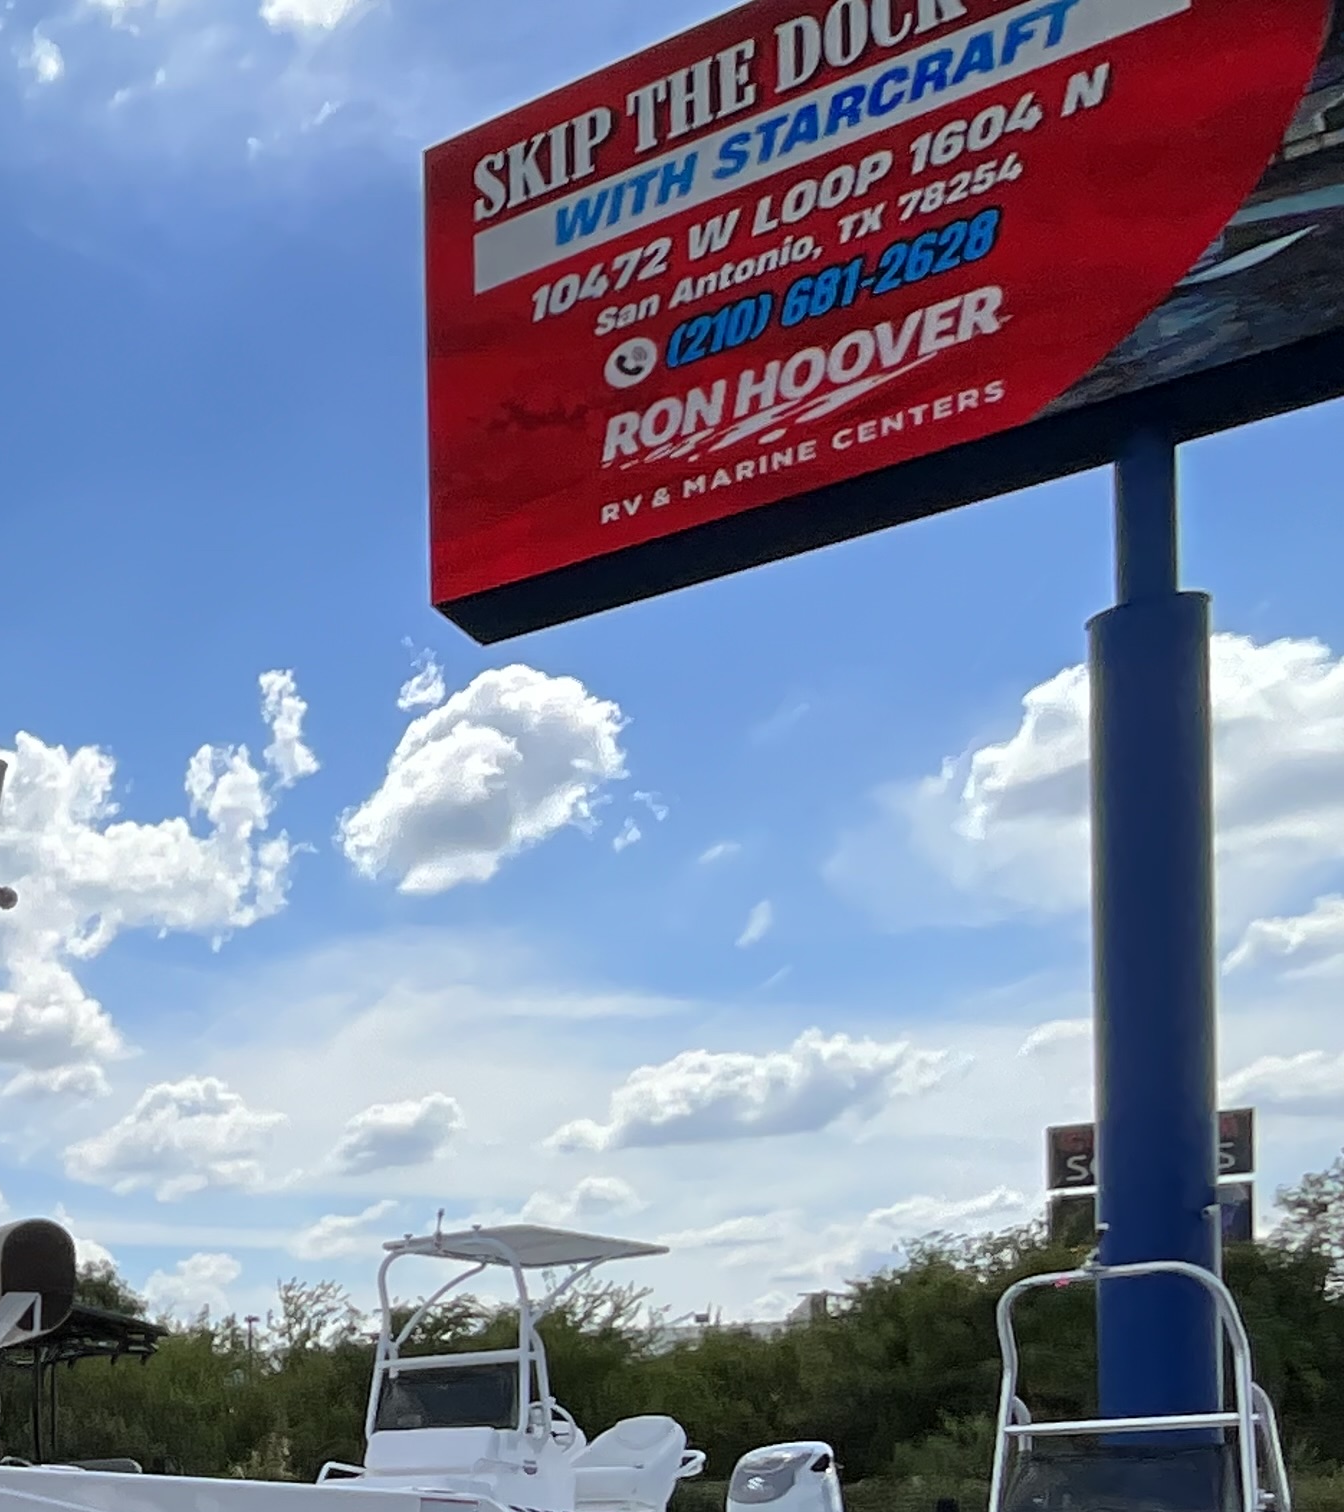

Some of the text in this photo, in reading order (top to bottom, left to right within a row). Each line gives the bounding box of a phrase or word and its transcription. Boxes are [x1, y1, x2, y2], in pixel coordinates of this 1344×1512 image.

[473, 107, 611, 222] SKIP
[626, 38, 757, 153] THE
[531, 62, 1111, 322] 10472 W LOOP 1604 N
[555, 0, 1080, 247] WITH STARCRAFT
[594, 153, 1024, 336] San Antonio, TX 78254
[665, 206, 1003, 369] (210) 681-2628
[600, 285, 1005, 465] RON HOOVER
[600, 380, 1007, 525] RV & MARINE CENTERS
